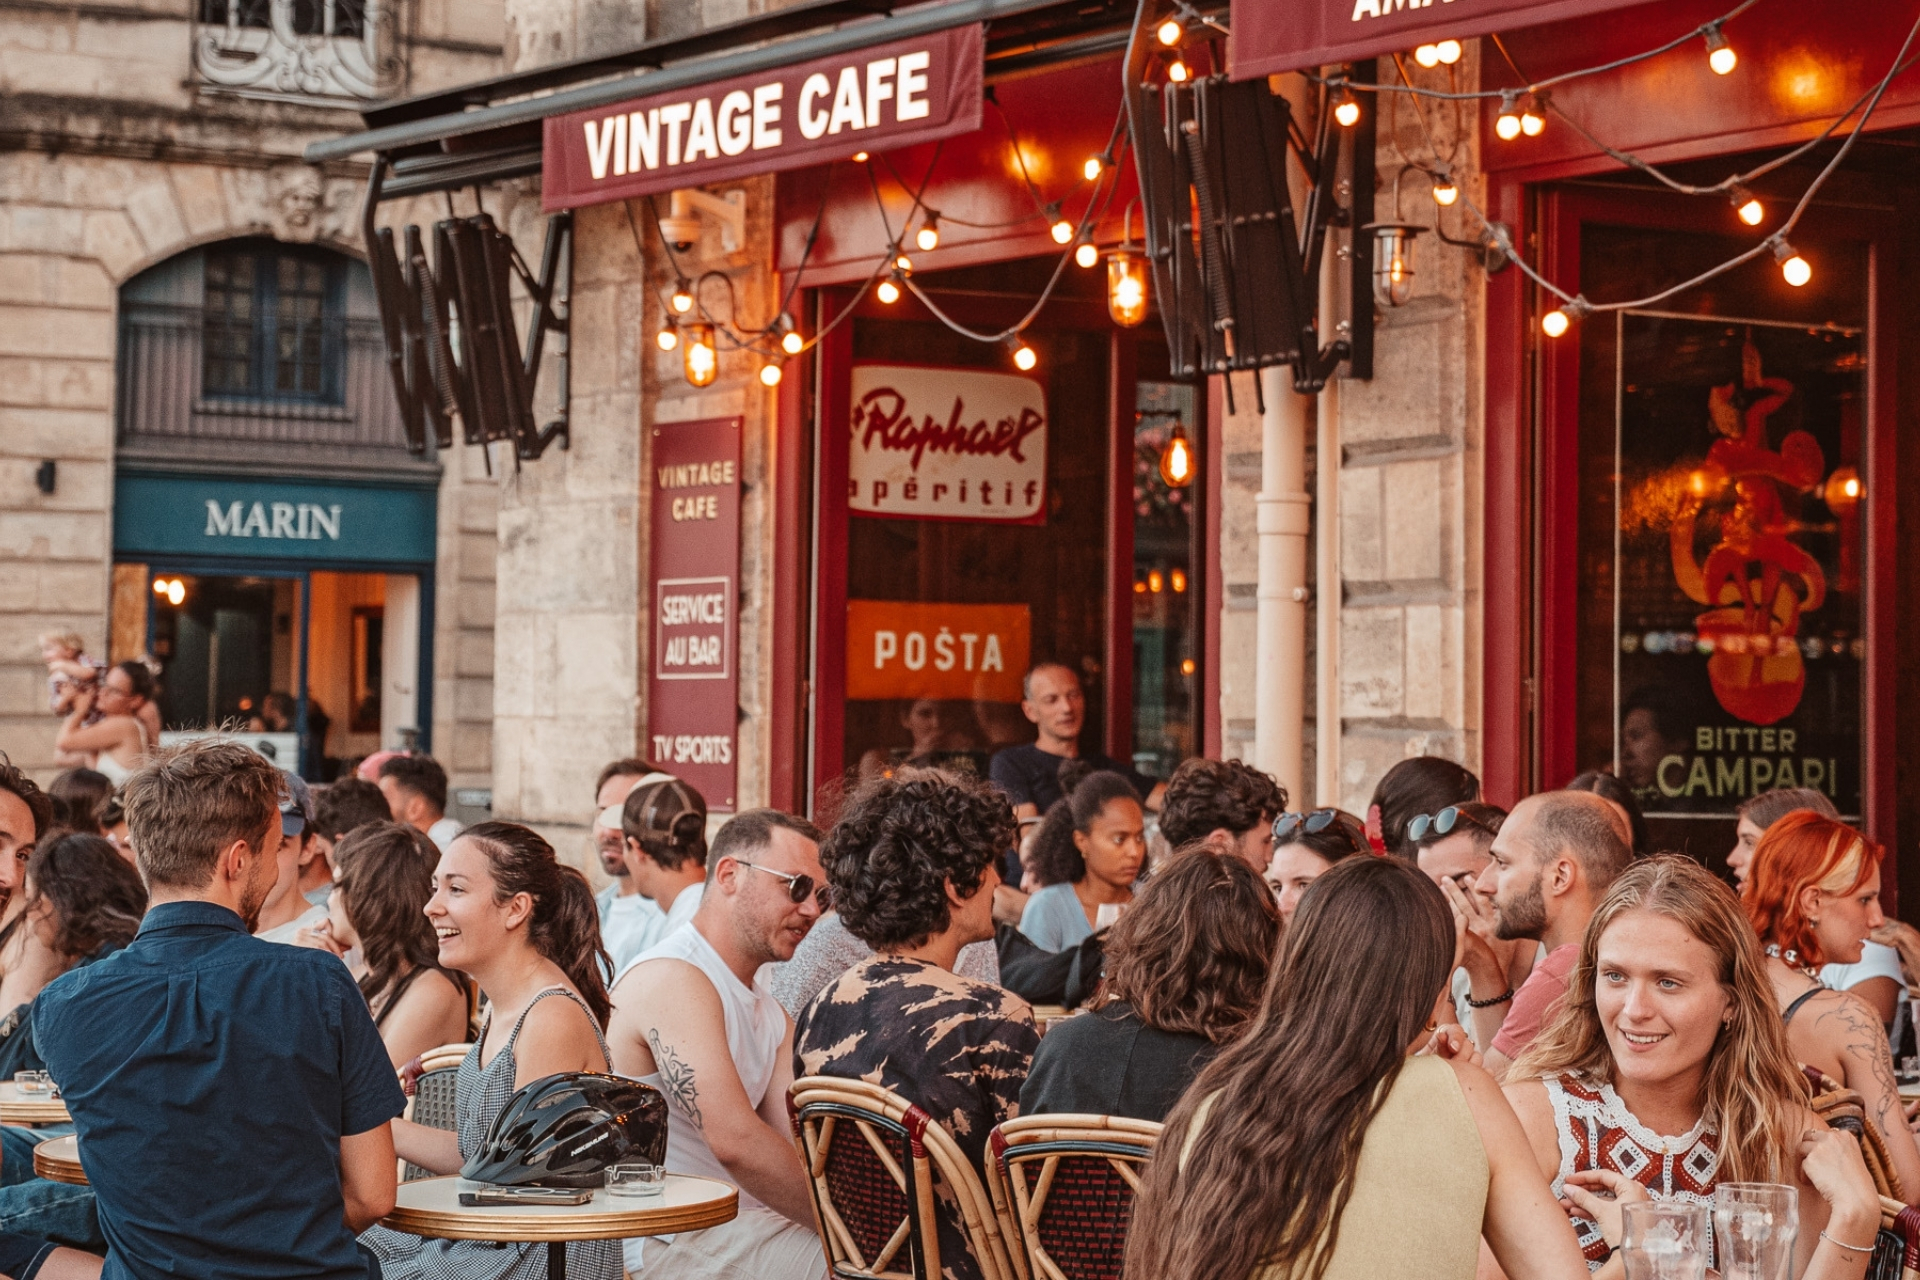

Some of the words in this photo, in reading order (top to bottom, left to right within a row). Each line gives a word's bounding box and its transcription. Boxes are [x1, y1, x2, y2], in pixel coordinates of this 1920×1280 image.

[583, 81, 784, 181] VINTAGE
[797, 50, 931, 141] CAFE
[657, 460, 735, 491] VINTAGE
[203, 498, 343, 540] MARIN
[671, 495, 719, 522] CAFE
[661, 593, 725, 627] SERVICE
[663, 636, 688, 667] AU
[688, 635, 721, 667] BAR
[873, 625, 1004, 673] POŠTA
[652, 734, 675, 764] TV
[674, 734, 733, 765] SPORTS
[1695, 725, 1798, 753] BITTER
[1655, 753, 1837, 799] CAMPARI
